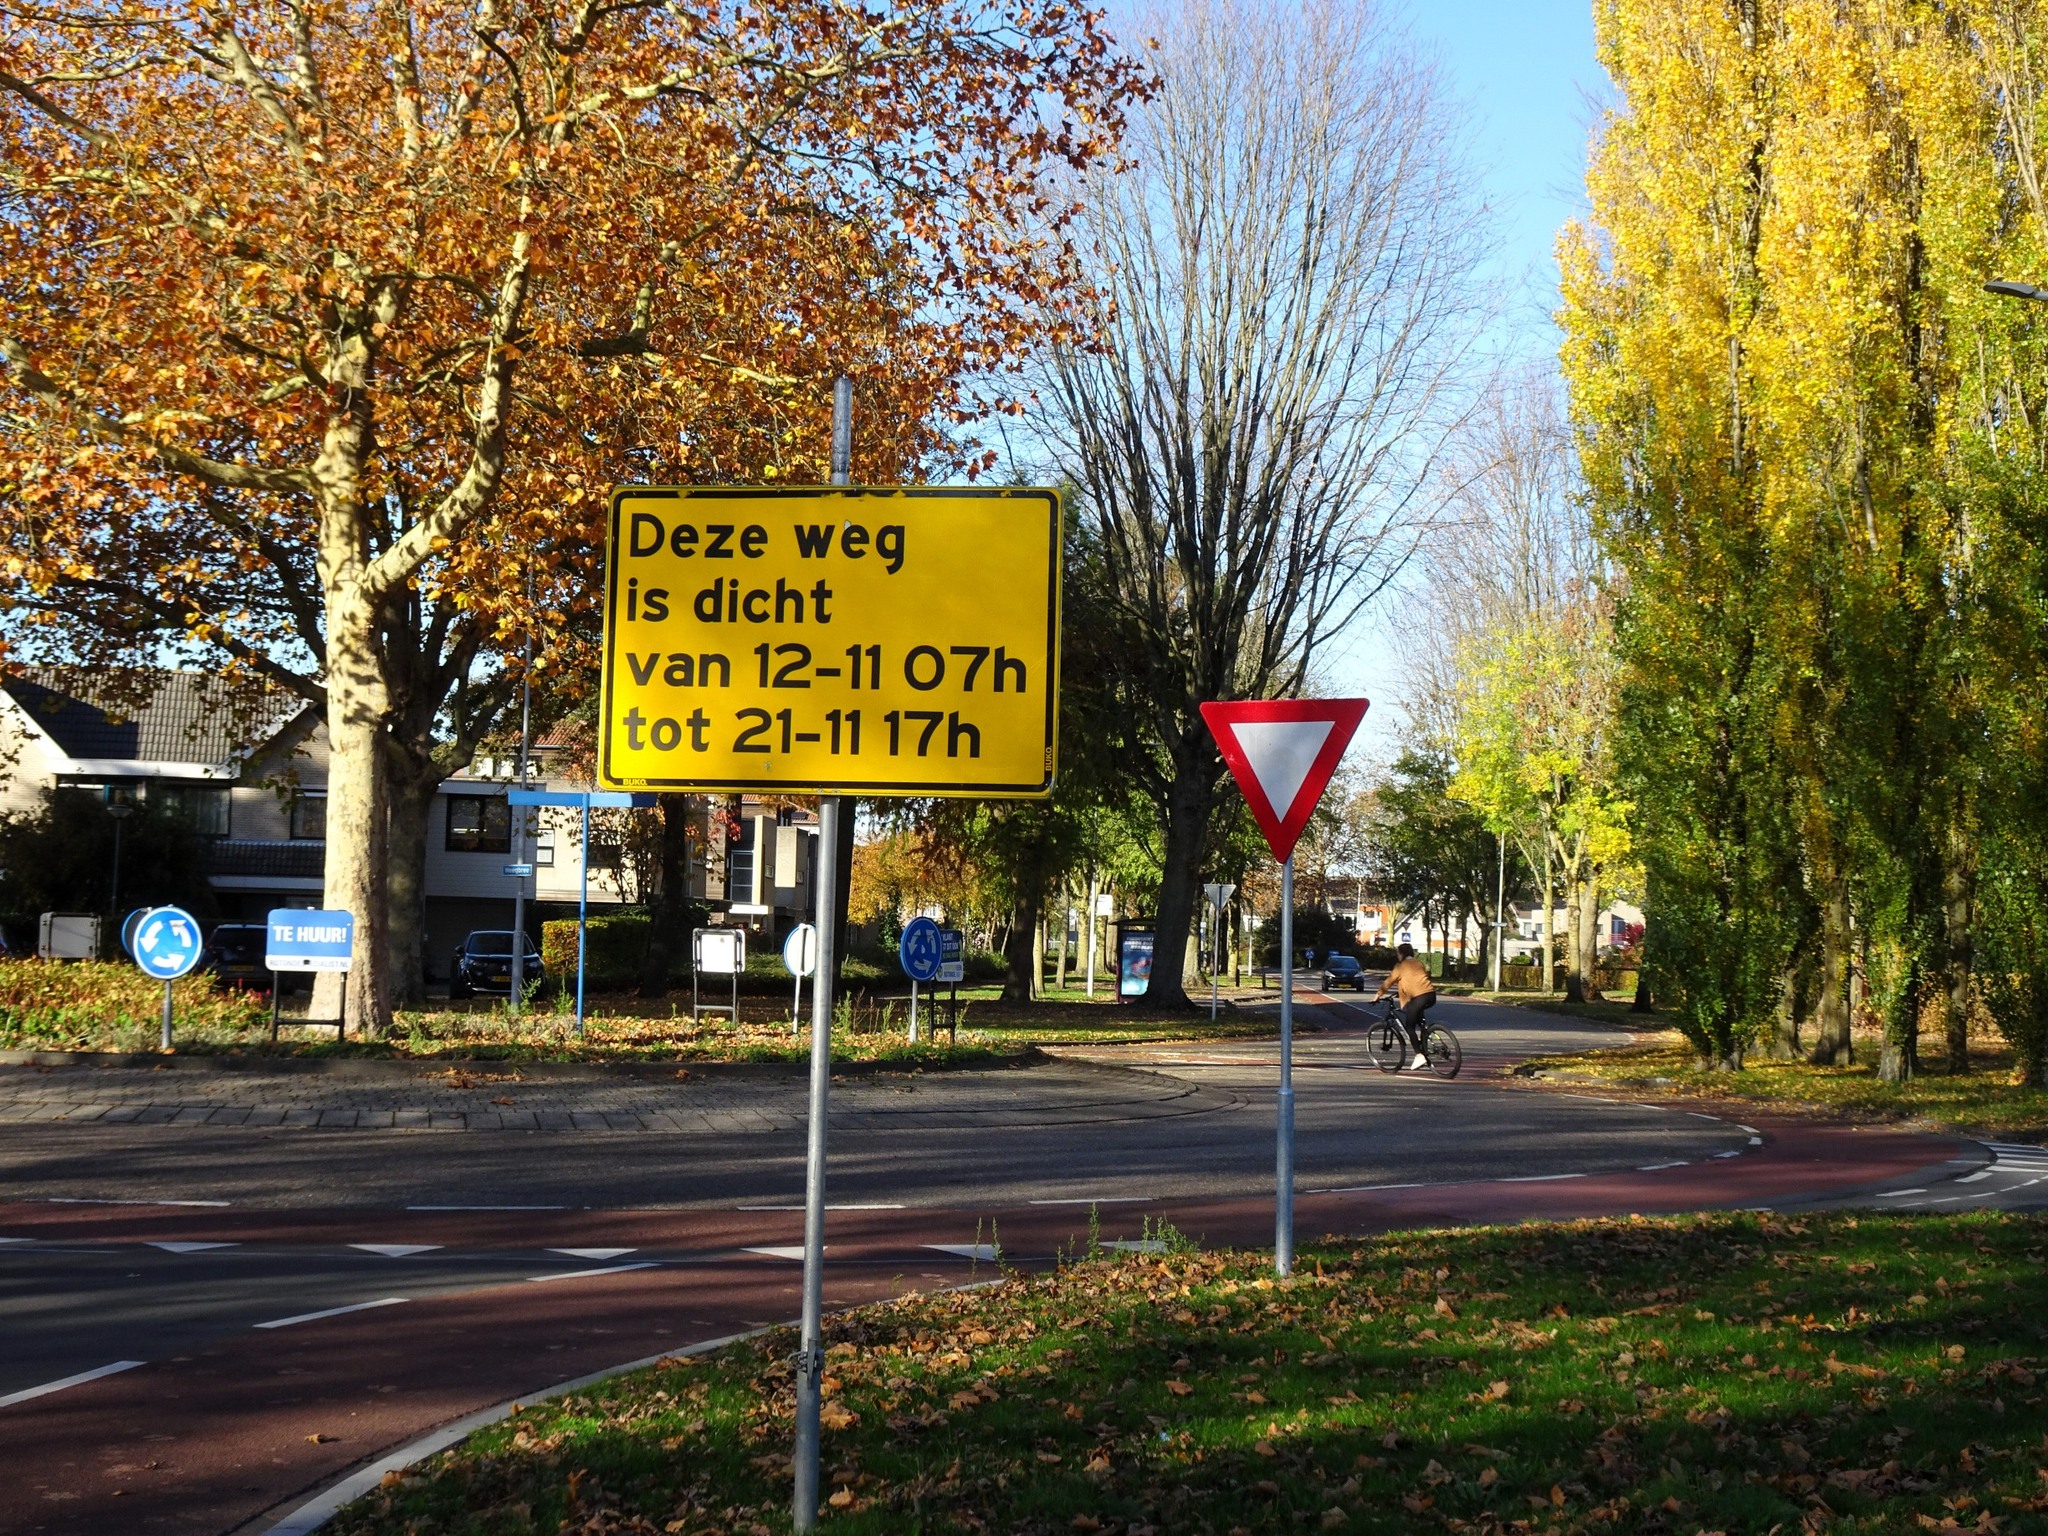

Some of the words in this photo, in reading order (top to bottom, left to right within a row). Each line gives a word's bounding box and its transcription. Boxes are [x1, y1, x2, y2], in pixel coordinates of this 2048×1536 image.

[630, 513, 768, 558] Deze
[794, 525, 906, 575] weg
[627, 577, 670, 622] is
[694, 577, 832, 623] dicht
[626, 652, 731, 688] van
[754, 643, 881, 689] 12-11
[904, 645, 1026, 693] 07h
[623, 706, 711, 752] tot
[733, 708, 861, 755] 21-11
[884, 711, 981, 758] 17h
[272, 926, 294, 942] TE
[296, 926, 347, 943] HUUR!
